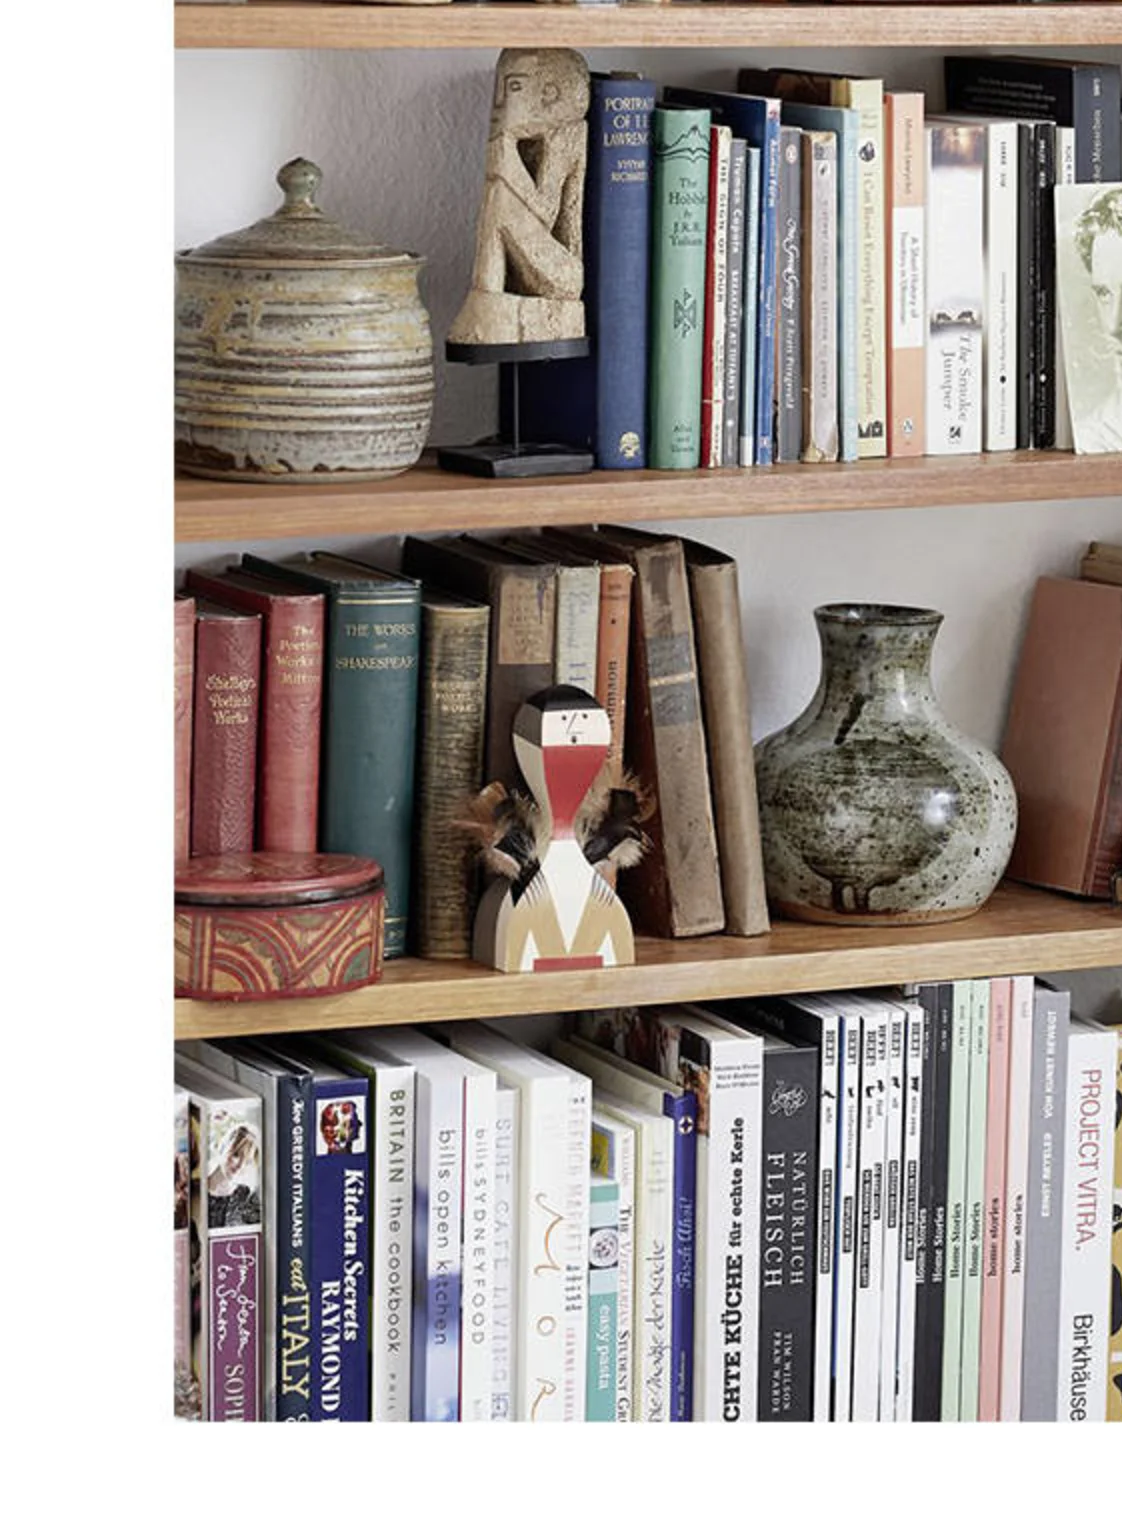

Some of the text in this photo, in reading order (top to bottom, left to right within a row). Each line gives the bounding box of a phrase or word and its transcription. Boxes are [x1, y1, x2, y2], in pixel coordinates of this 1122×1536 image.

[613, 114, 631, 129] OF
[679, 177, 697, 189] The
[726, 155, 744, 401] Truman Capote BREAKFAST AT TIFFANY'S
[861, 242, 874, 305] Everything
[941, 350, 956, 410] Jumper
[958, 333, 971, 422] The Smoke
[345, 621, 416, 638] THE WORKS
[387, 1088, 405, 1183] BRITAIN
[1075, 1069, 1102, 1251] PROJECT VITRA.
[343, 1168, 365, 1341] Kitchen Secrets
[387, 1196, 403, 1233] the
[433, 1129, 456, 1345] bills open kitchen
[471, 1128, 488, 1345] bills SYDNEYFOOD
[619, 1205, 632, 1233] THE
[764, 1151, 786, 1288] FLEISCH
[790, 1151, 809, 1285] NATÜRLICH
[917, 1207, 928, 1247] Stories
[931, 1205, 944, 1283] Home Stories
[949, 1202, 962, 1279] Home Stories
[968, 1201, 981, 1277] Home Stories
[987, 1197, 1000, 1277] home stories
[1011, 1194, 1023, 1275] home stories
[282, 1125, 311, 1399] GREEDY ITALIANS eat ITALY
[385, 1242, 403, 1353] cookbook
[720, 1117, 744, 1422] CHTE KÜCHE für echte Kerle
[215, 1263, 237, 1351] to Season
[321, 1279, 341, 1411] RAYMOND
[596, 1304, 611, 1389] easy pasta
[618, 1329, 630, 1391] STUDENT
[771, 1331, 782, 1414] FRAN WARDE
[783, 1333, 792, 1411] TIM WILSON
[1070, 1313, 1094, 1421] Birkhäuse
